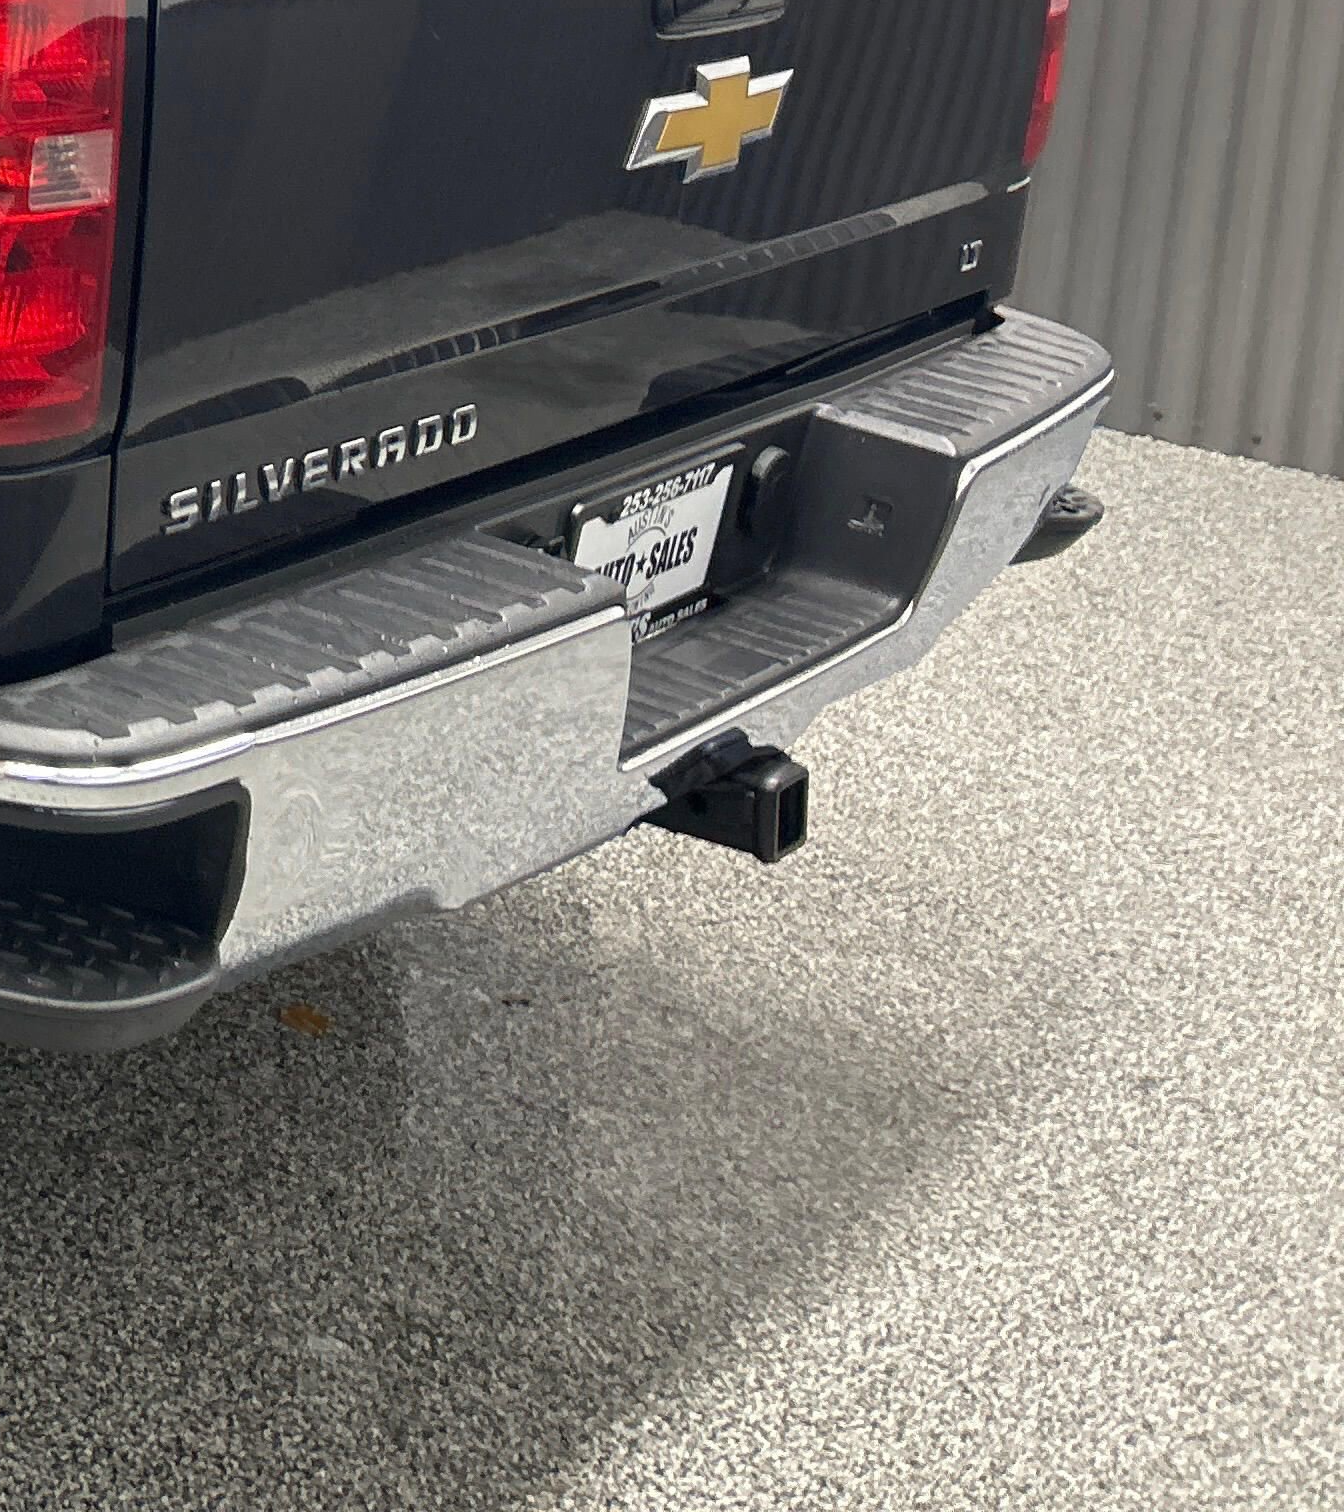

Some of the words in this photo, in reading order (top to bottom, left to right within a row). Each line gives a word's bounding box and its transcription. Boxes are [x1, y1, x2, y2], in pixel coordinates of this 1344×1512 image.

[160, 403, 479, 536] SILVERADO
[619, 461, 716, 520] 253-256-7117
[645, 526, 699, 580] SALES
